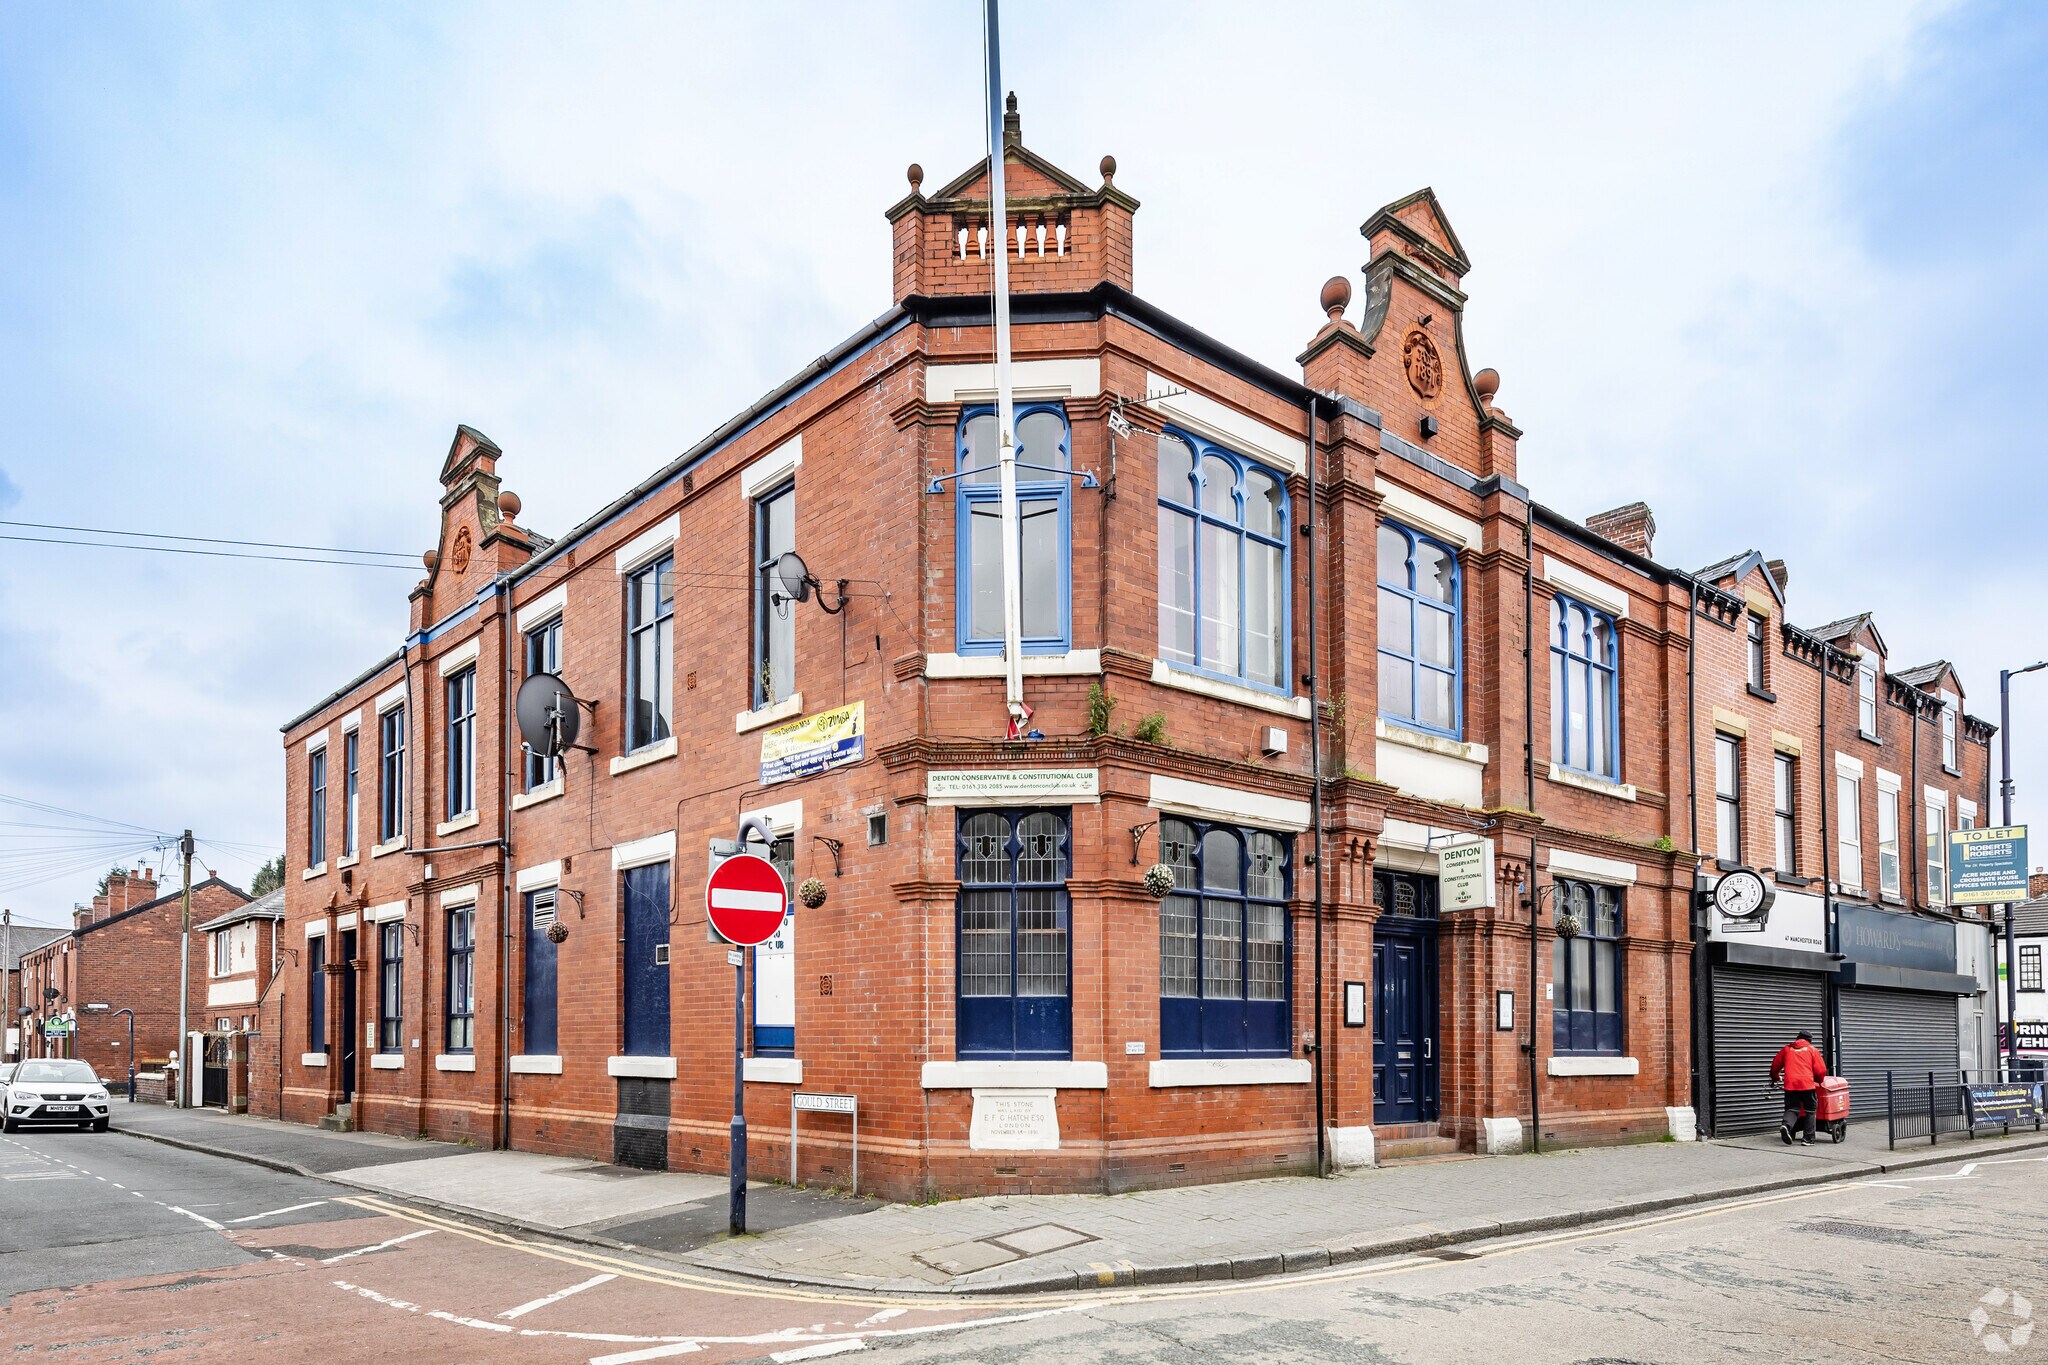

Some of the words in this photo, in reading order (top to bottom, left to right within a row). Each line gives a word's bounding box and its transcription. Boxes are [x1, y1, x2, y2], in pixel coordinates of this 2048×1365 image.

[781, 724, 800, 735] Denton
[1964, 832, 1982, 841] TO
[1987, 829, 2012, 839] LET
[1970, 843, 2012, 851] ROBERTS
[1444, 847, 1481, 860] DENTON
[1970, 849, 2012, 857] ROBERTS
[1446, 859, 1479, 868] CONSERVATIVE
[1444, 873, 1482, 882] CONSTITUTIONAL
[1790, 936, 1812, 944] MANCHESTER
[797, 1096, 822, 1107] GOULD
[825, 1097, 854, 1109] STREET
[1031, 1114, 1045, 1122] ESQ
